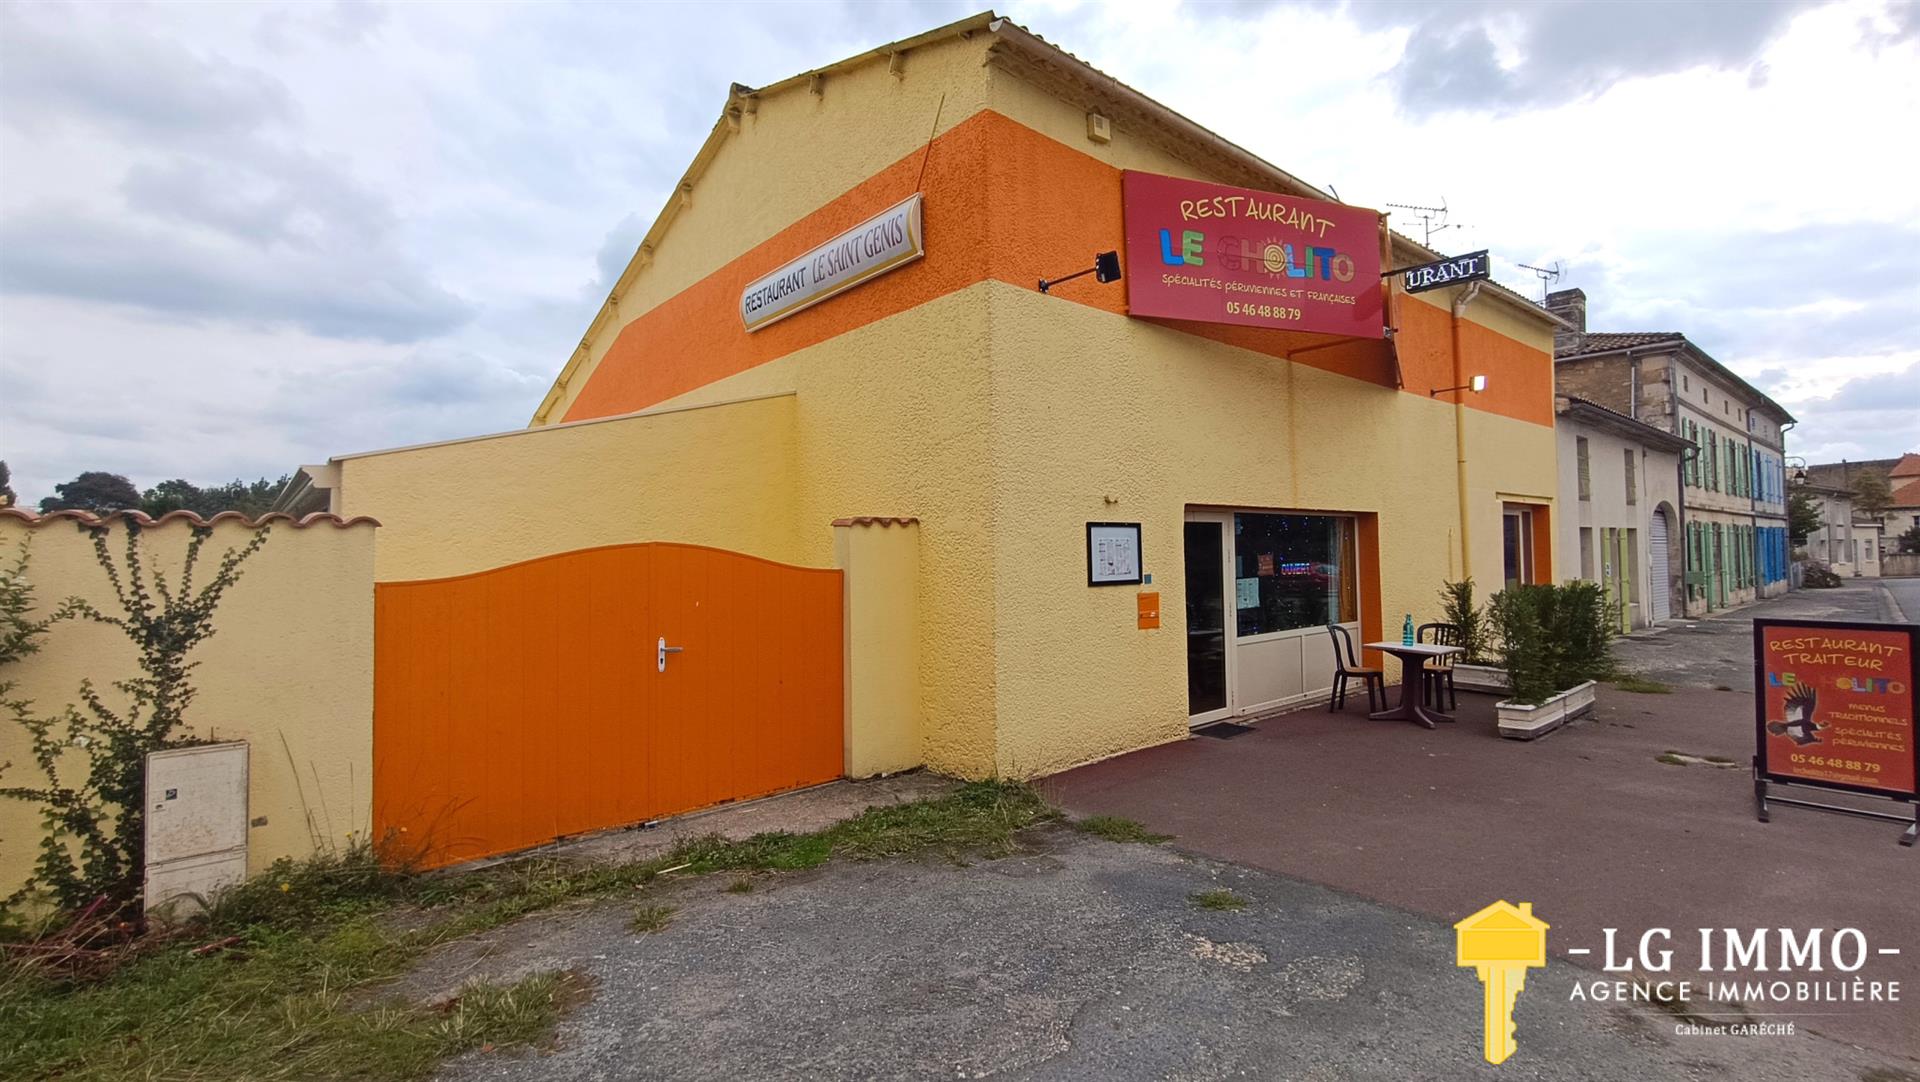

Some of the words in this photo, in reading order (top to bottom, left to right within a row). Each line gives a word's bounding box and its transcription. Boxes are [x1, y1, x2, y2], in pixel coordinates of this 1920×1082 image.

[1180, 197, 1335, 238] RESTAURANT
[745, 267, 806, 314] RESTAURANT
[812, 254, 826, 283] LE
[827, 235, 863, 277] SAINT
[864, 214, 904, 258] GENIS
[1159, 228, 1204, 266] LE
[1217, 235, 1354, 282] CHOLITO
[1162, 273, 1222, 290] SPÉCIALITÉS
[1290, 289, 1303, 299] ET
[1227, 301, 1240, 314] 05
[1242, 303, 1256, 316] 46
[1257, 305, 1271, 318] 48
[1273, 306, 1286, 319] 88
[1288, 308, 1301, 321] 79
[1770, 638, 1902, 657] RESTAURANT
[1783, 653, 1883, 672] TRAITEUR
[1768, 672, 1796, 688] LE
[1790, 753, 1806, 763] 05
[1808, 756, 1825, 766] 46
[1826, 758, 1843, 768] 48
[1845, 760, 1861, 771] 88
[1864, 762, 1881, 773] 79
